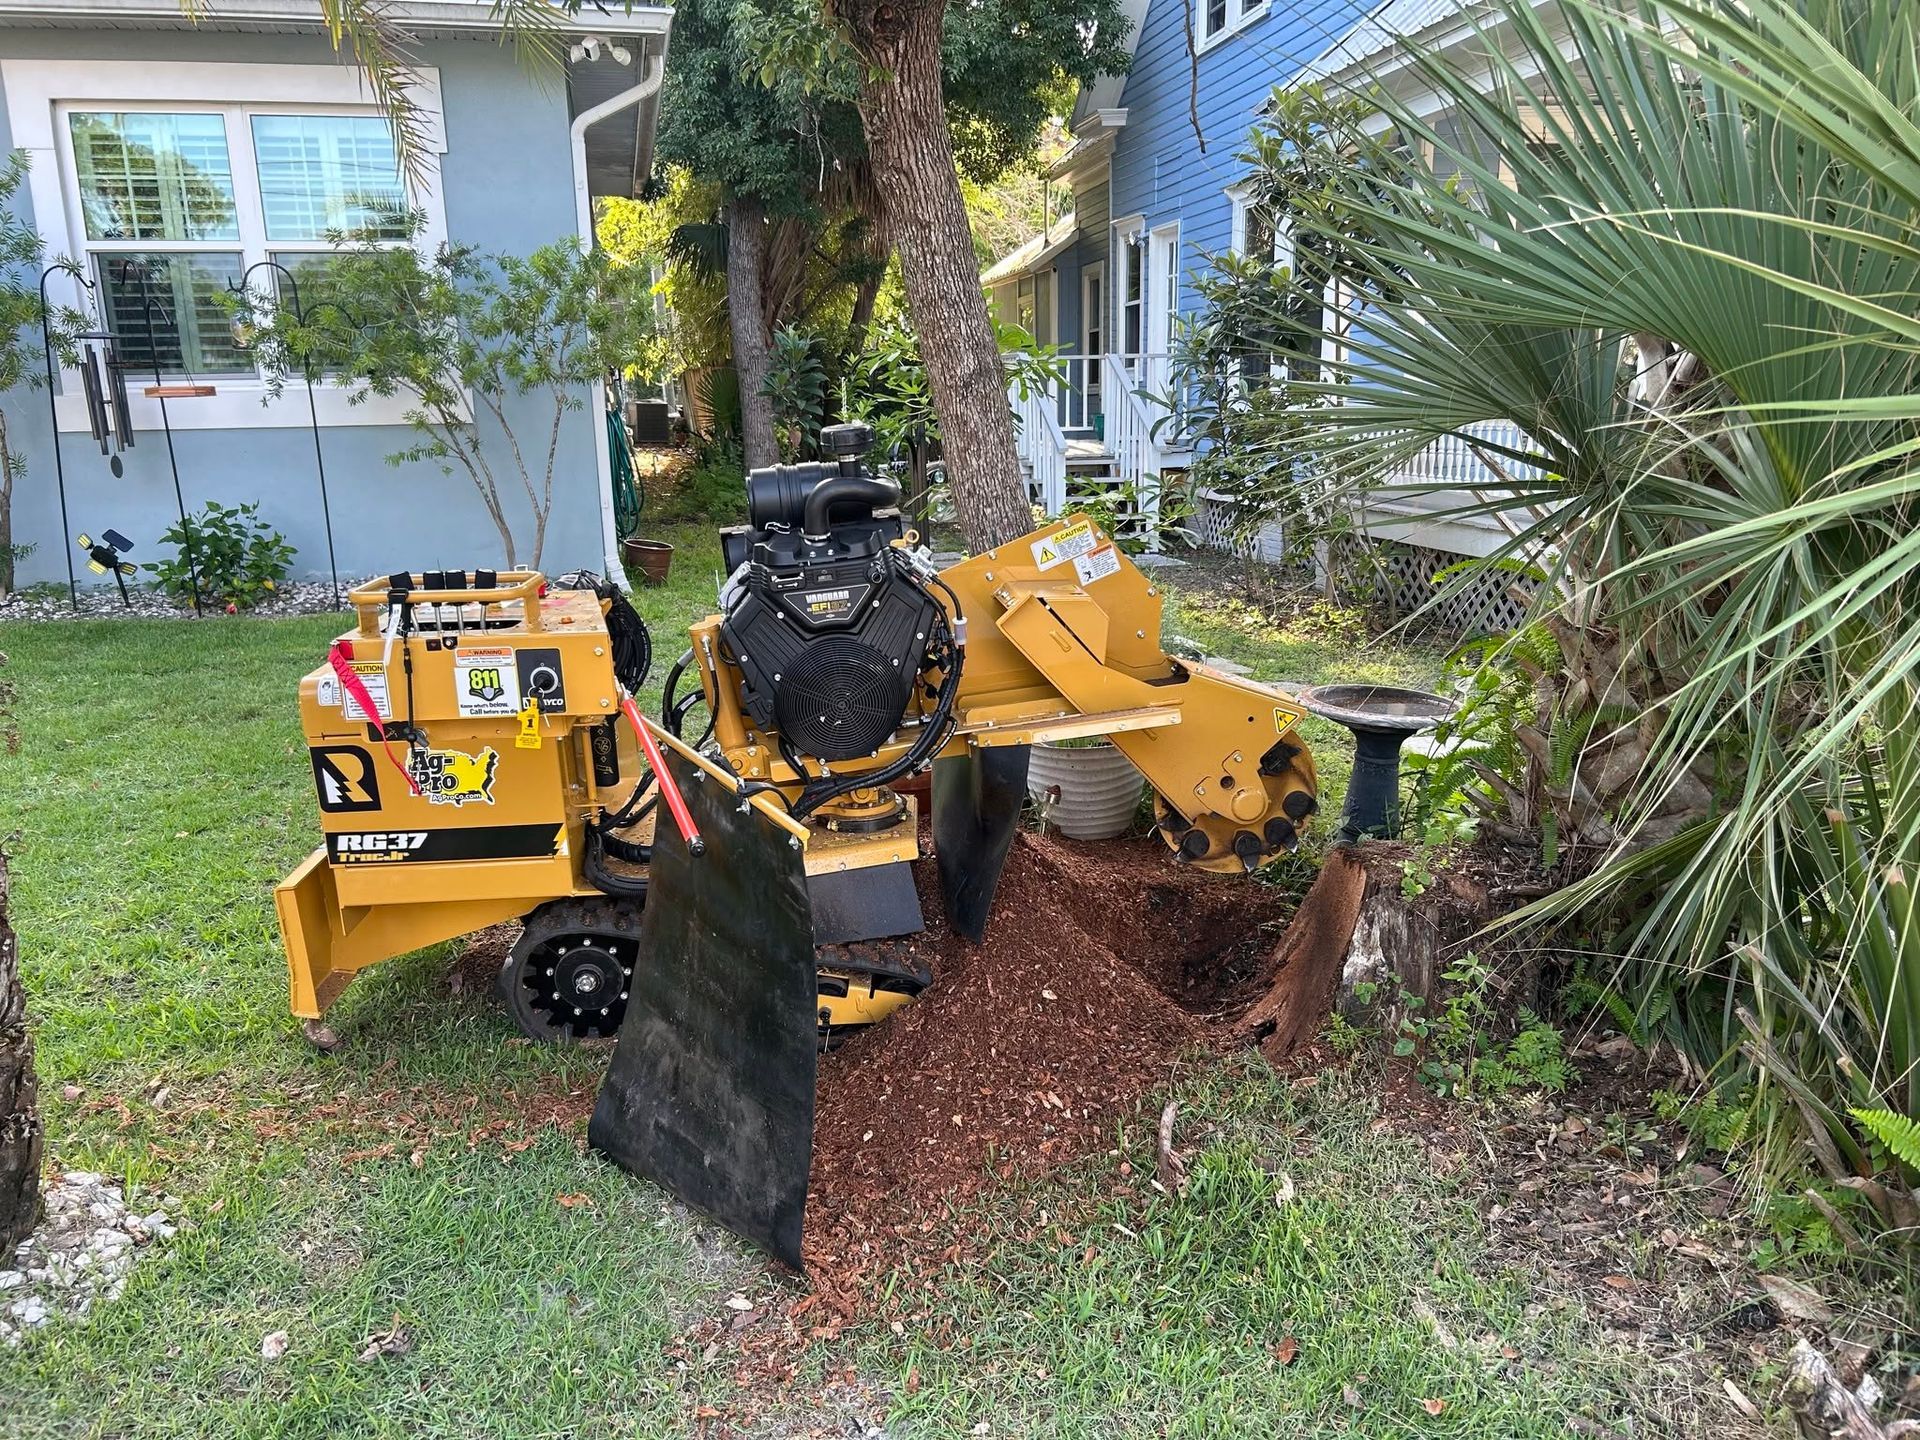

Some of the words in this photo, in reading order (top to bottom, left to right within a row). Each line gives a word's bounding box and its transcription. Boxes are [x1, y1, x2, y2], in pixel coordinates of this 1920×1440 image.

[1060, 523, 1088, 541] CAUTION
[805, 590, 850, 604] VANGUARD
[469, 668, 501, 691] 811
[527, 718, 534, 728] 1
[416, 771, 457, 793] Pro
[432, 793, 481, 802] AgProCo.com
[337, 832, 428, 851] RG37
